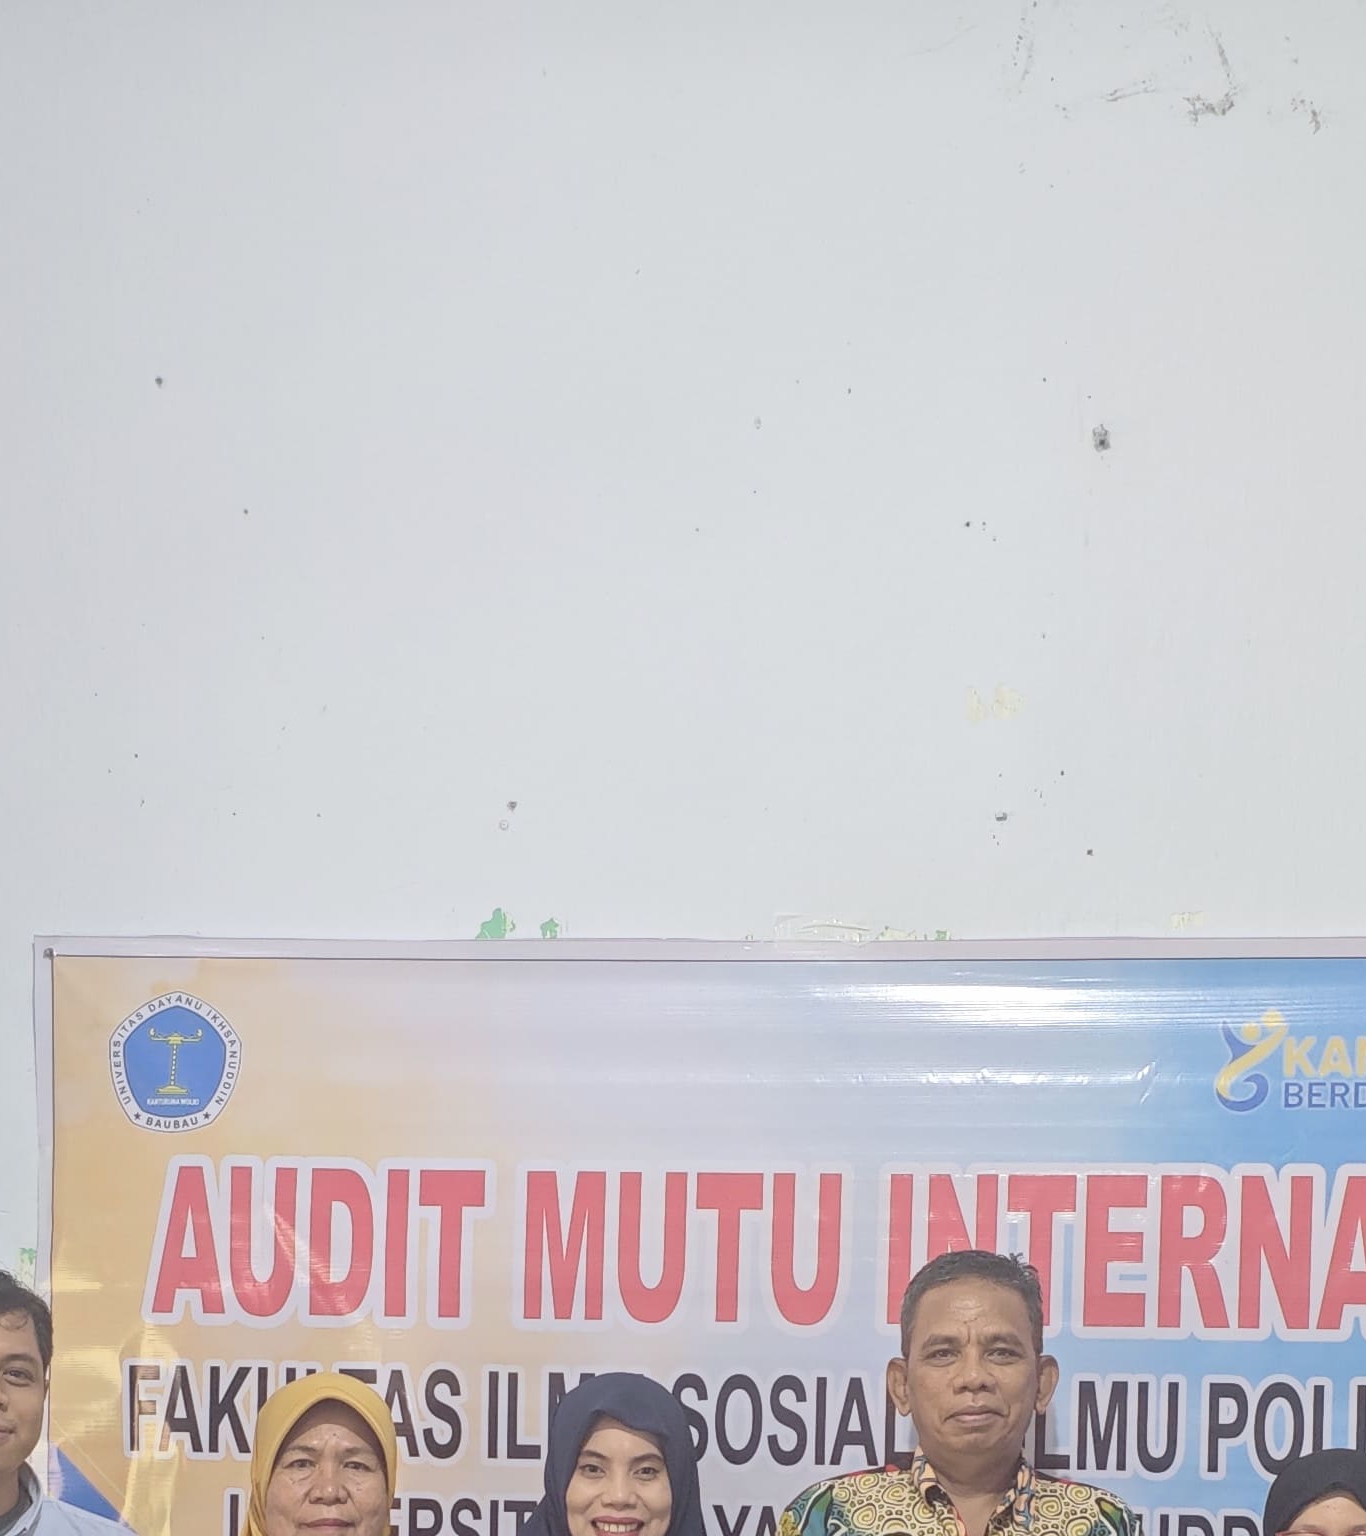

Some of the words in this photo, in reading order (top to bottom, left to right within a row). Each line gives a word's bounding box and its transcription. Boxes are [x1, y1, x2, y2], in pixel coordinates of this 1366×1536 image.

[112, 1012, 144, 1105] UNIVERSITAS
[147, 995, 202, 1013] DAYANU
[206, 1009, 239, 1106] IKHSANUDDIN
[146, 1116, 199, 1129] BAUBAU
[150, 1164, 487, 1320] AUDIT
[523, 1169, 843, 1325] MUTU
